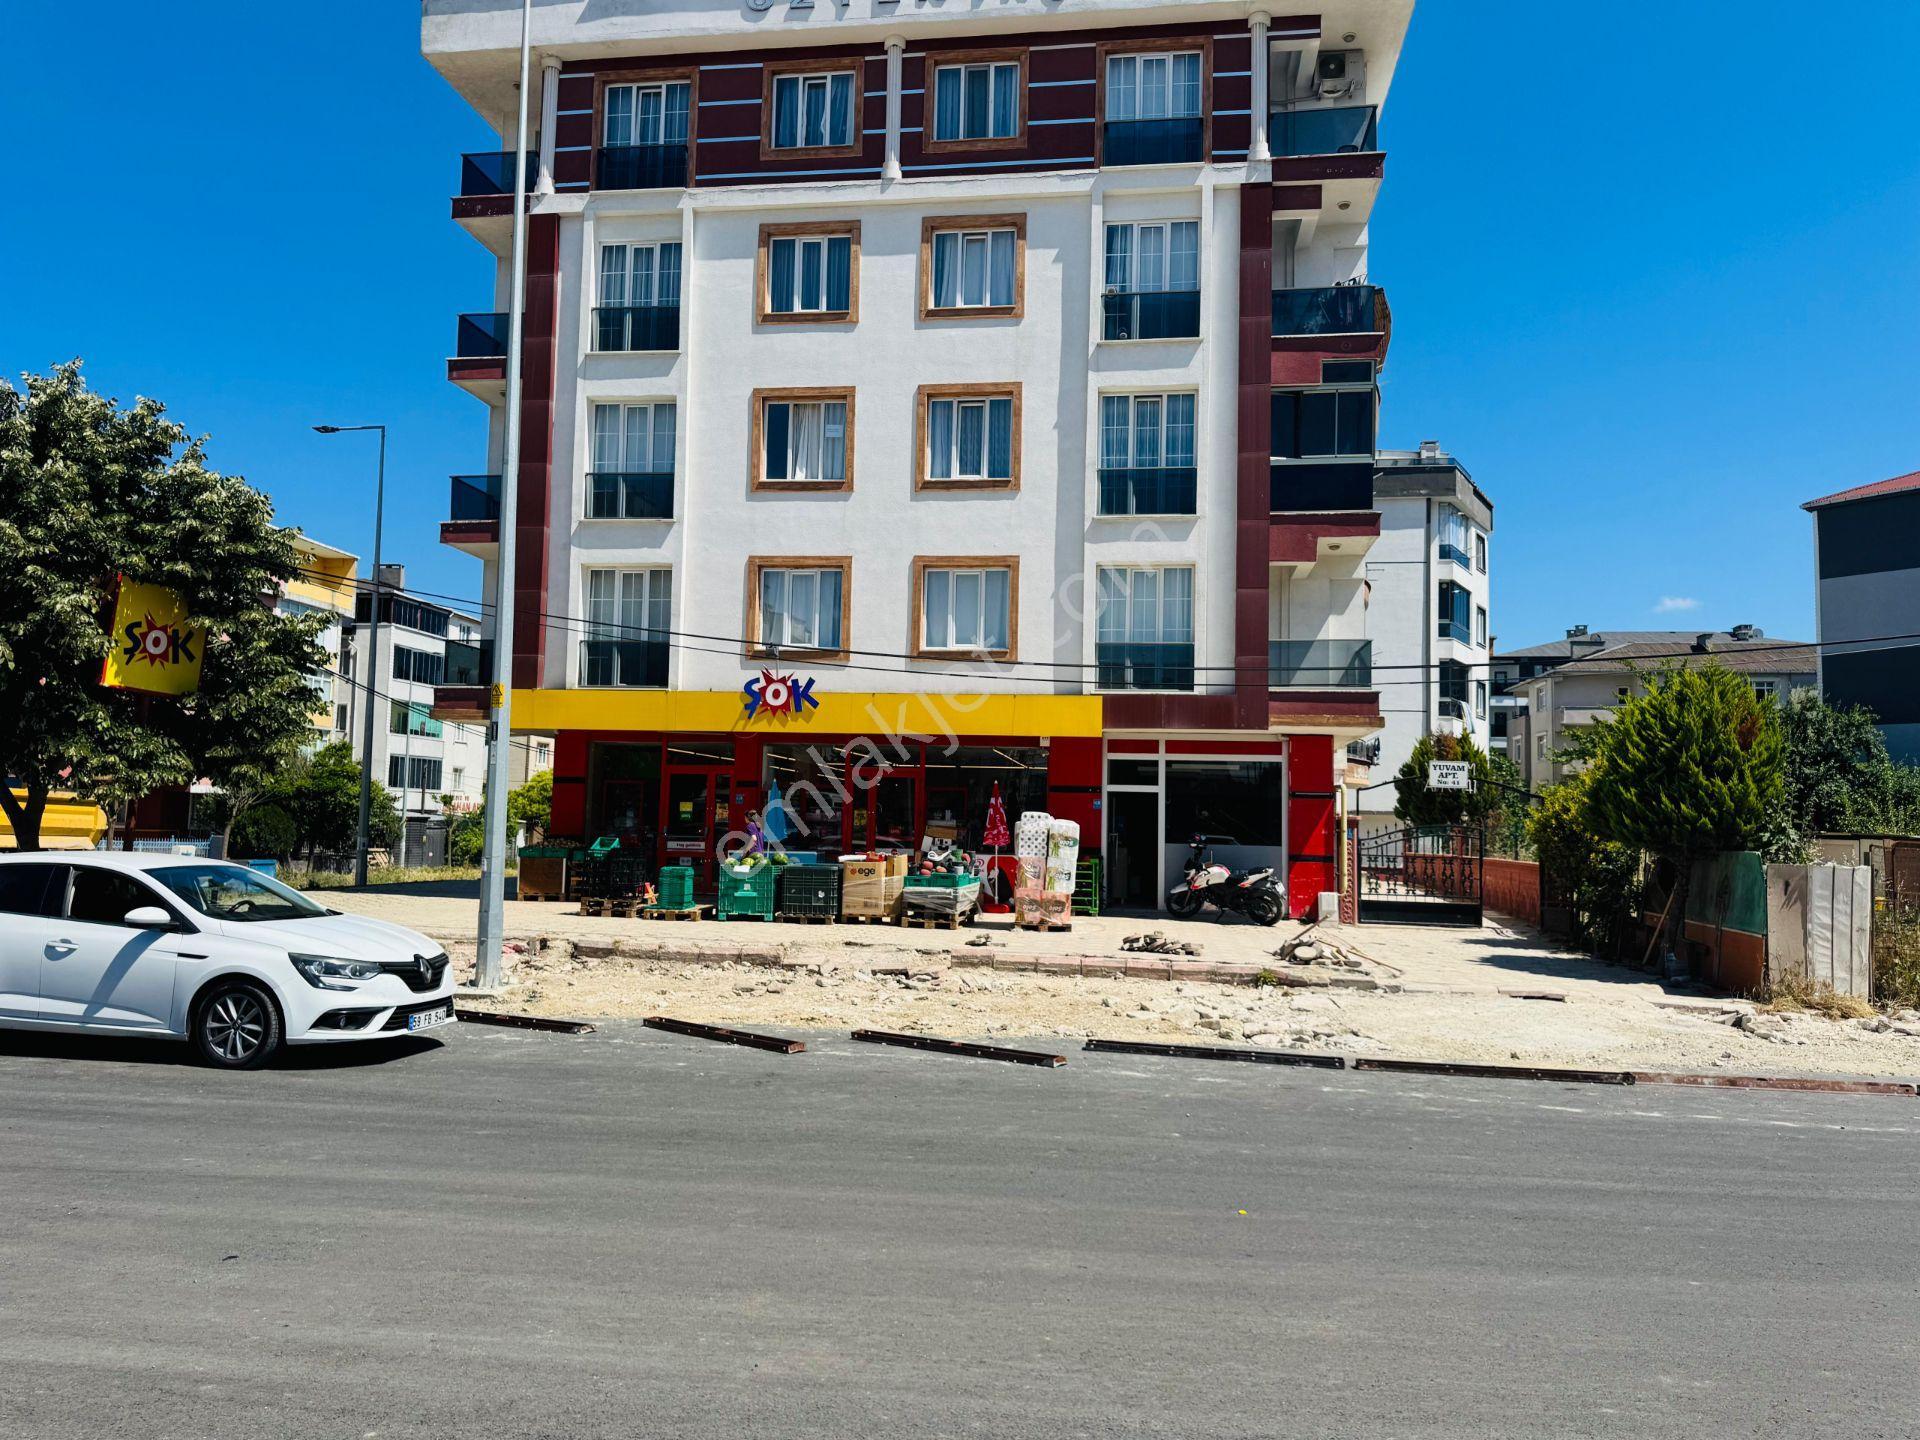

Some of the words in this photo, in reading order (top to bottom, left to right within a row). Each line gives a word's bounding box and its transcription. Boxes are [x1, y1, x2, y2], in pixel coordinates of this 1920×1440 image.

[124, 621, 197, 666] ŞOK
[744, 676, 820, 720] ŞOK
[857, 867, 876, 876] ege
